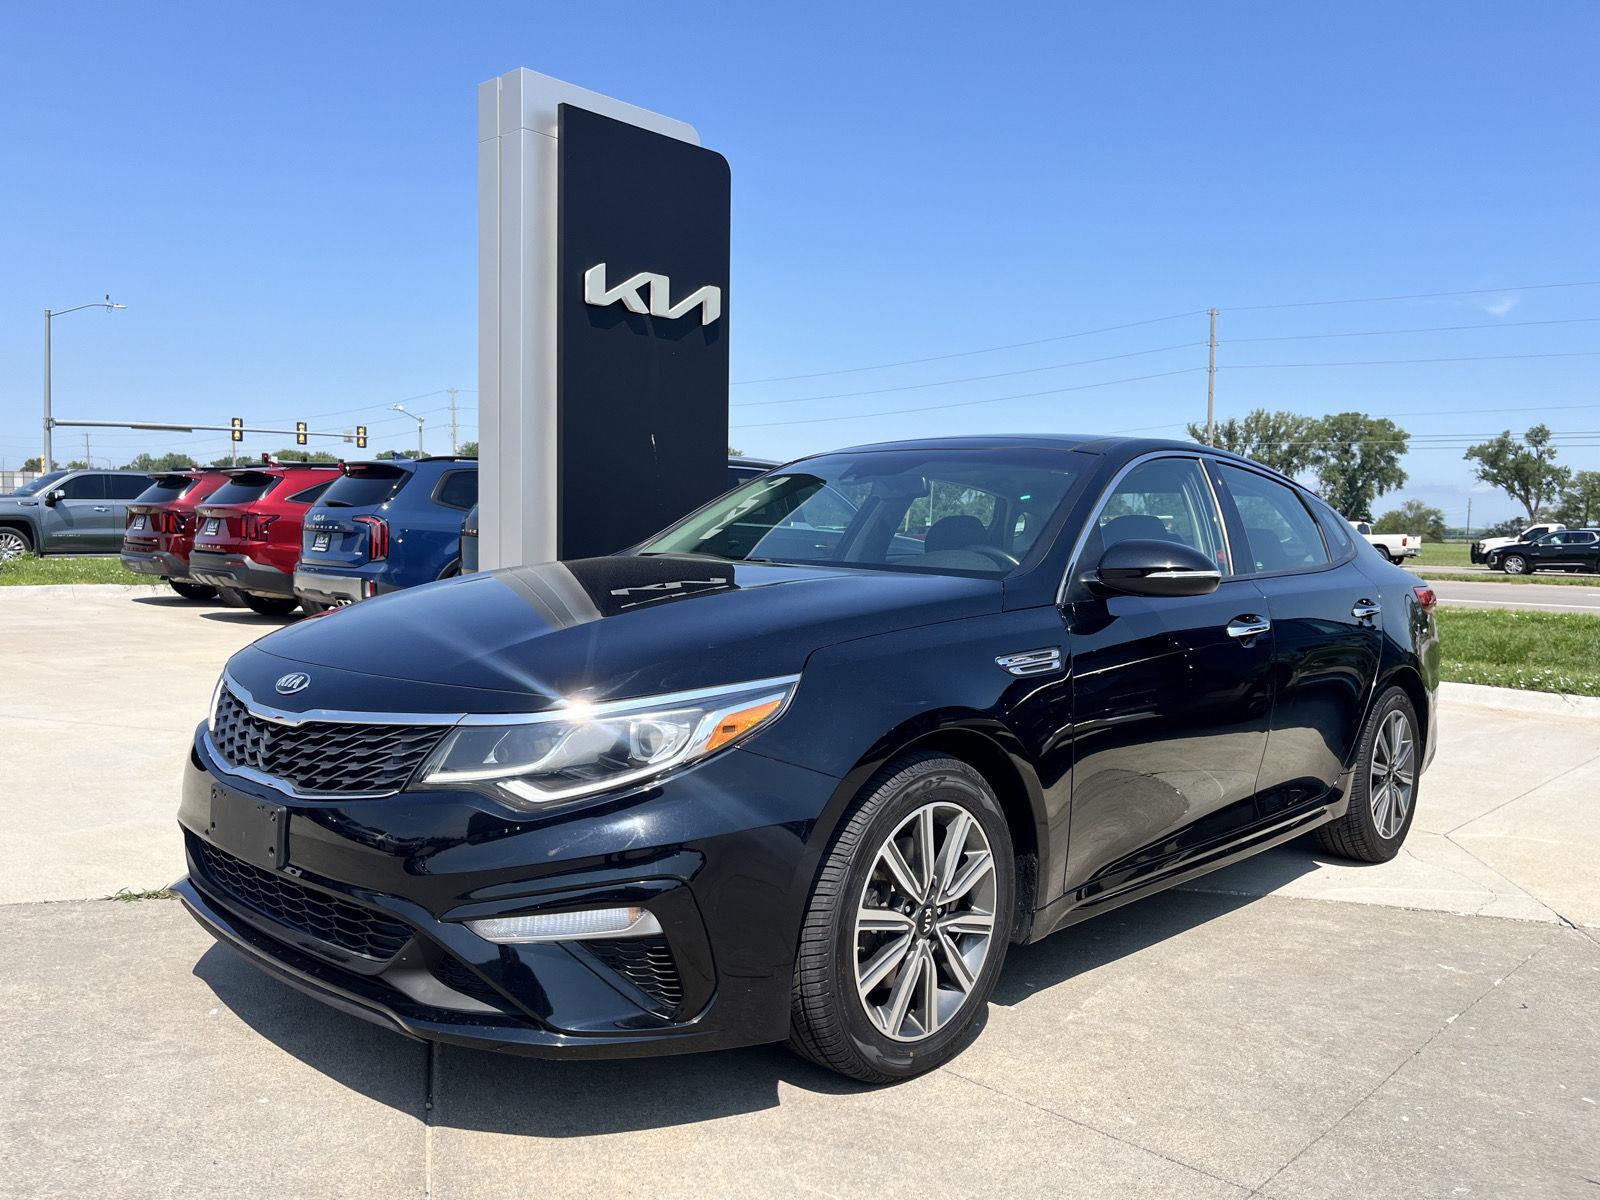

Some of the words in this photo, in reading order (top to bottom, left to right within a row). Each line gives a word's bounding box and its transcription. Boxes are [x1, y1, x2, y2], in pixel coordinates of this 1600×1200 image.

[584, 262, 721, 326] KIA
[276, 673, 306, 690] KIA
[923, 908, 932, 933] KIA
